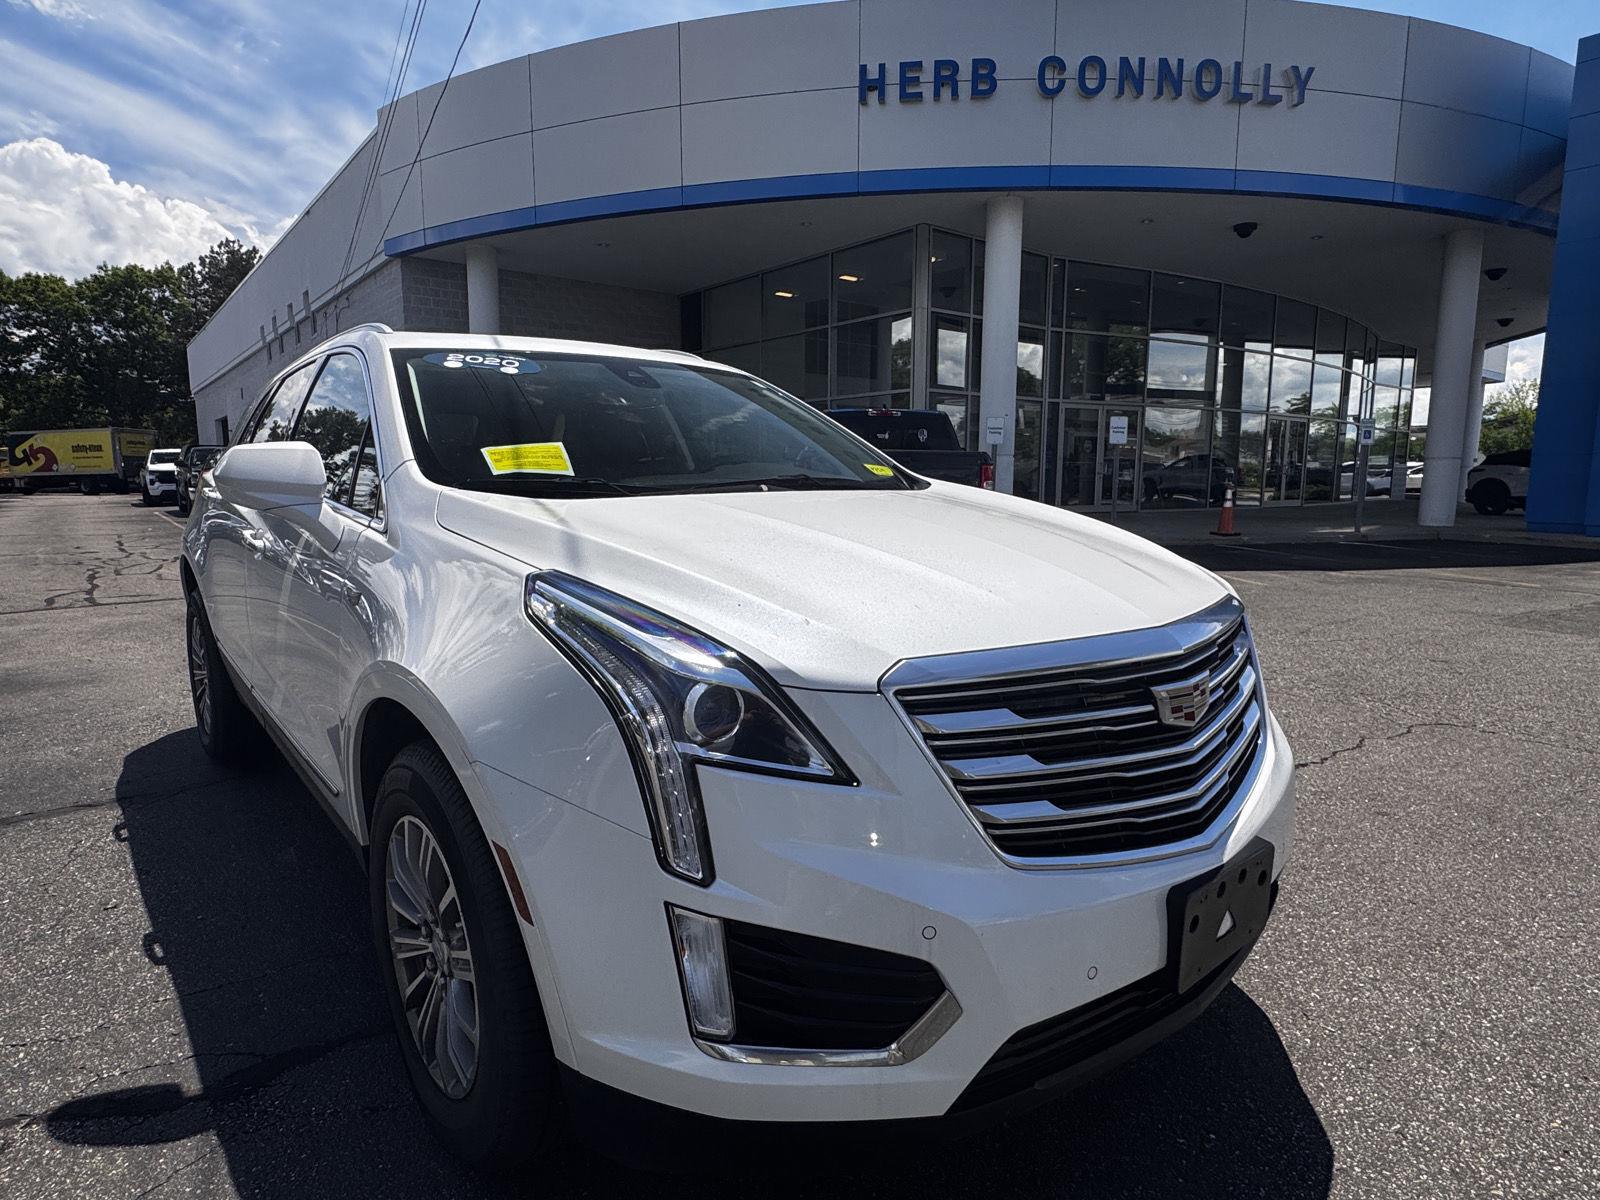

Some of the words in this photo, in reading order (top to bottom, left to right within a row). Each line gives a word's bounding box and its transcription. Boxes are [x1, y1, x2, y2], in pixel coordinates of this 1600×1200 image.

[858, 57, 998, 105] HERB
[1036, 55, 1316, 107] CONNOLLY
[446, 353, 520, 368] 2020
